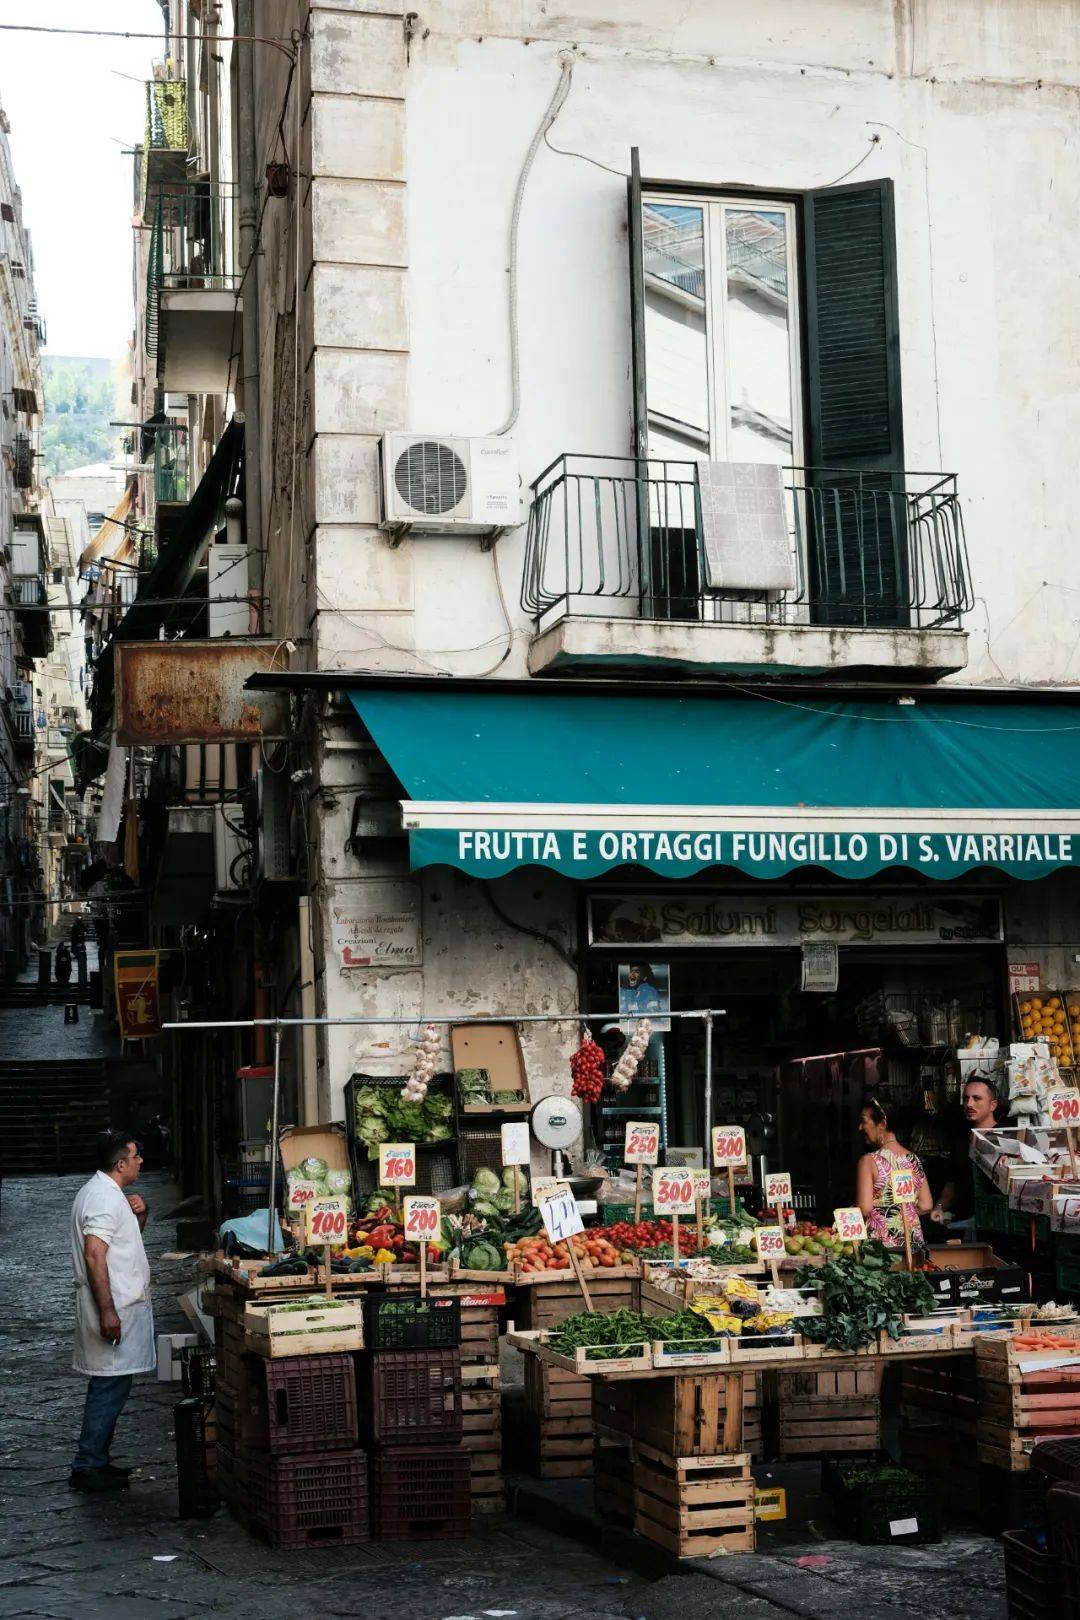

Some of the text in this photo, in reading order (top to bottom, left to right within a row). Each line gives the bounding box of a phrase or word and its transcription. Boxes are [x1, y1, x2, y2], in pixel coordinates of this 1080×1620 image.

[459, 832, 1073, 862] FRUTTA E ORTAGGI FUNGILLO DI S. VARRIALE
[661, 904, 936, 940] Salumi Surgelati
[375, 941, 415, 955] Elma
